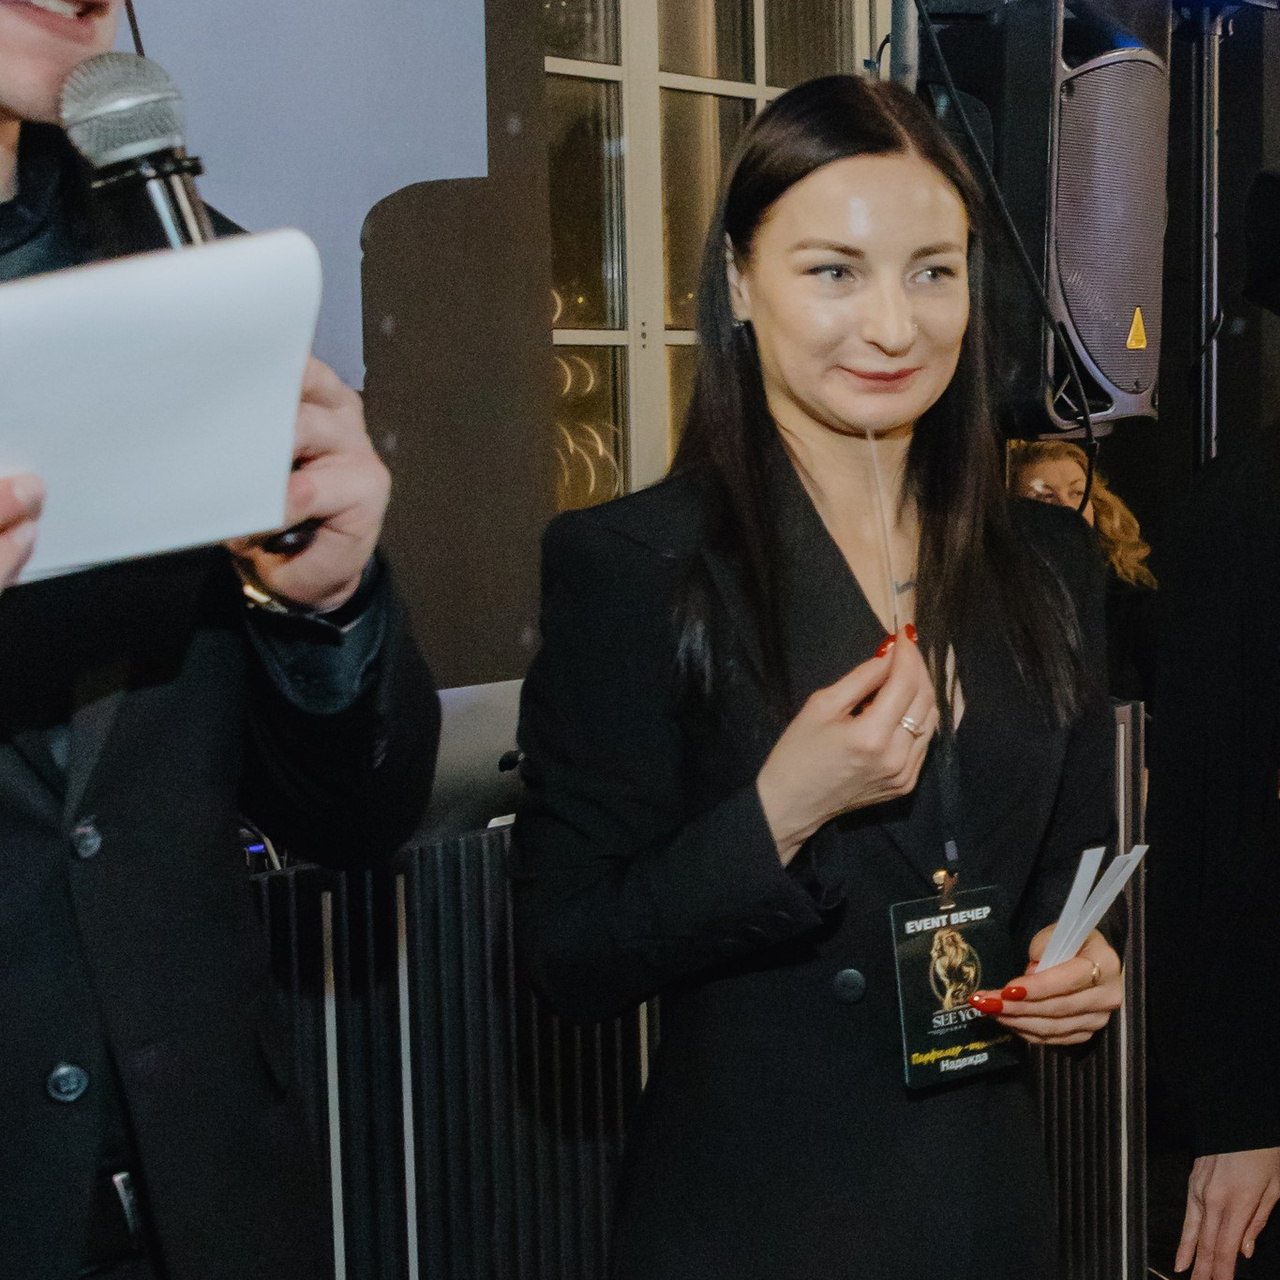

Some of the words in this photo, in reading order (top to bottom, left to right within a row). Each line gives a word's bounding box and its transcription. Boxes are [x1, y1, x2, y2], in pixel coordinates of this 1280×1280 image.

[904, 914, 948, 934] EVENT
[950, 905, 992, 925] ВЕЧЕР
[932, 1011, 958, 1029] SEE
